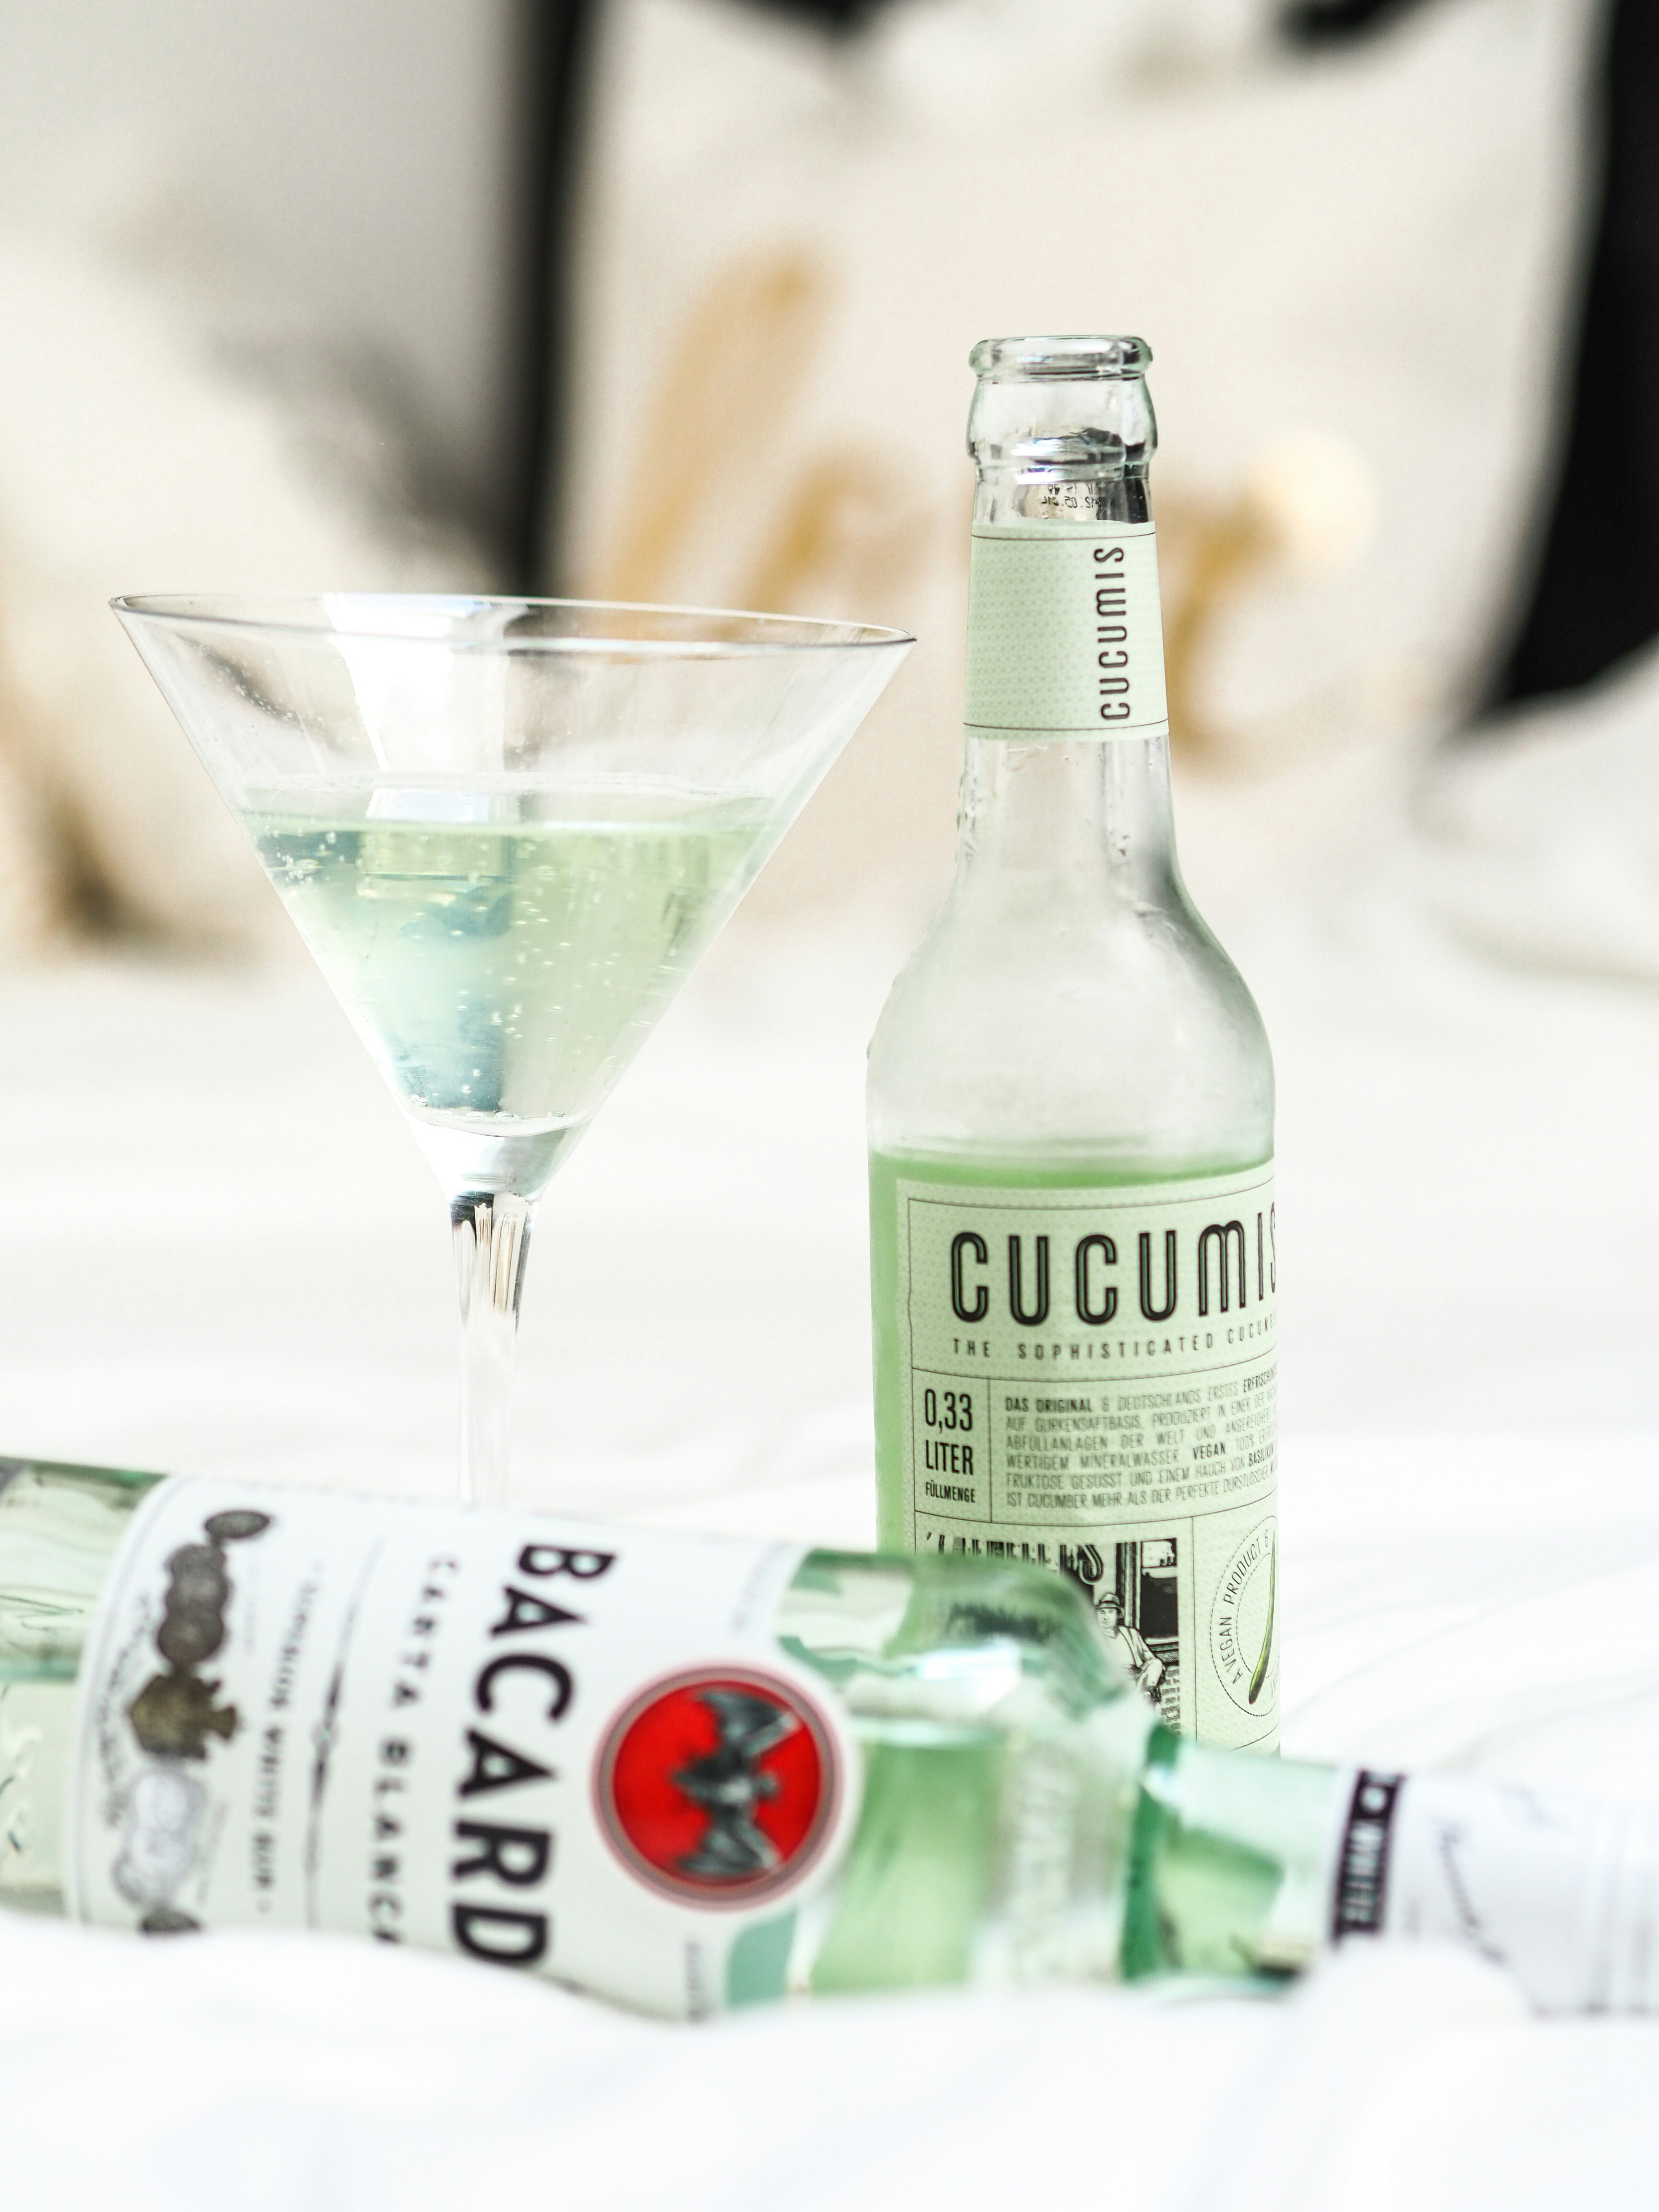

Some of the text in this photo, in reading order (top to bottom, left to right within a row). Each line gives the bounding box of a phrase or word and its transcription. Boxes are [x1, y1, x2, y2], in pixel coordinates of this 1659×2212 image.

[1094, 547, 1131, 721] CUCUMIS
[953, 1337, 991, 1357] THE
[1017, 1333, 1213, 1359] SOPHISTICATED
[925, 1388, 973, 1434] 0,33
[1005, 1397, 1029, 1413] DAS
[1036, 1398, 1093, 1413] ORIGINAL
[1118, 1389, 1201, 1412] DEUTSCHLANDS
[1208, 1382, 1238, 1402] ERSTES
[1006, 1416, 1025, 1431] AUF
[1152, 1406, 1211, 1427] PRODUZIERT
[1218, 1405, 1226, 1418] IN
[1231, 1397, 1251, 1416] EINER
[1255, 1391, 1265, 1408] DER
[1120, 1433, 1144, 1449] DER
[1156, 1429, 1184, 1446] WELT
[926, 1439, 974, 1476] LITER
[1007, 1454, 1069, 1471] WERTIGEM
[1007, 1472, 1064, 1490] FRUKTOSE
[1130, 1471, 1152, 1486] UND
[1159, 1467, 1190, 1484] EINEM
[1195, 1461, 1226, 1478] HAUCH
[1231, 1456, 1246, 1472] VON
[926, 1479, 975, 1503] FÜLLMENGE
[1007, 1492, 1022, 1507] IST
[1028, 1493, 1088, 1509] CUCUMBER
[1092, 1492, 1123, 1507] MEHR
[1128, 1491, 1147, 1505] ALS
[1152, 1488, 1172, 1503] DER
[1176, 1480, 1220, 1501] PERFEKTE
[1223, 1536, 1262, 1605] PRODUCT
[1219, 1616, 1236, 1674] VEGAN
[1232, 1667, 1244, 1685] A
